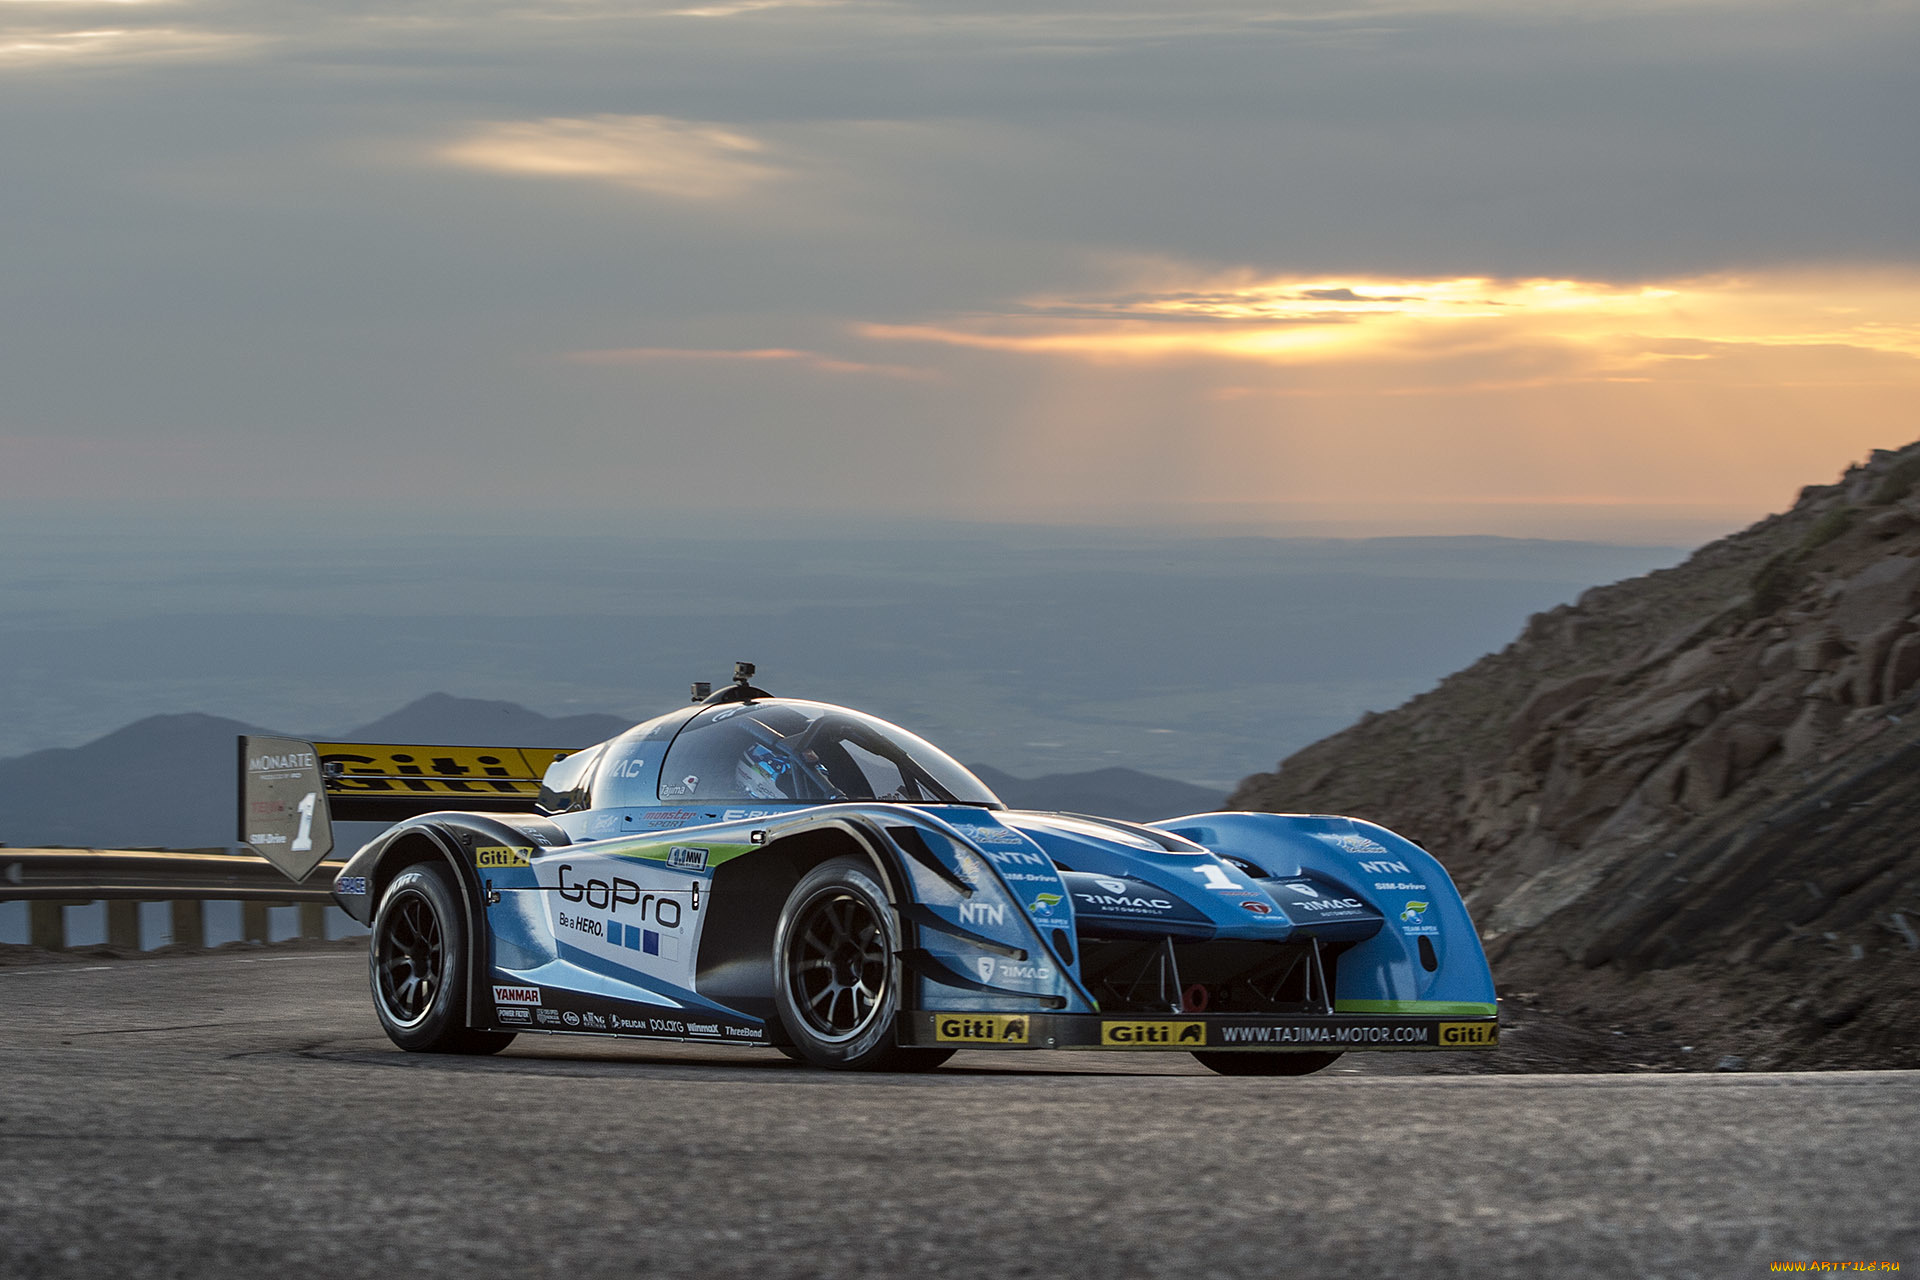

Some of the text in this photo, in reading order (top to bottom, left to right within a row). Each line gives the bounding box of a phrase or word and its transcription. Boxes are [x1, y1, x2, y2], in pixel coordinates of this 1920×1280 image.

[249, 753, 313, 771] MONARTE
[320, 754, 520, 792] Giti
[291, 793, 316, 851] 1
[644, 809, 697, 820] monster
[480, 851, 507, 865] Giti
[988, 851, 1045, 865] NTN
[1358, 861, 1411, 873] NTN
[1192, 864, 1243, 890] 1
[559, 865, 681, 928] GoPro
[1074, 894, 1173, 909] RIMAC
[1291, 898, 1363, 911] RIMAC
[960, 903, 1005, 926] NTN
[560, 912, 604, 937] Be a HERO.
[1000, 966, 1049, 979] RIMAC
[495, 988, 539, 1002] YANMAR
[621, 1020, 646, 1029] PELICAN
[725, 1026, 762, 1037] ThreeBond
[942, 1019, 993, 1038] Giti
[1109, 1026, 1168, 1042] Giti
[1222, 1027, 1428, 1042] WWW.TAJIMA-MOTOR.COM
[1443, 1027, 1482, 1043] Giti
